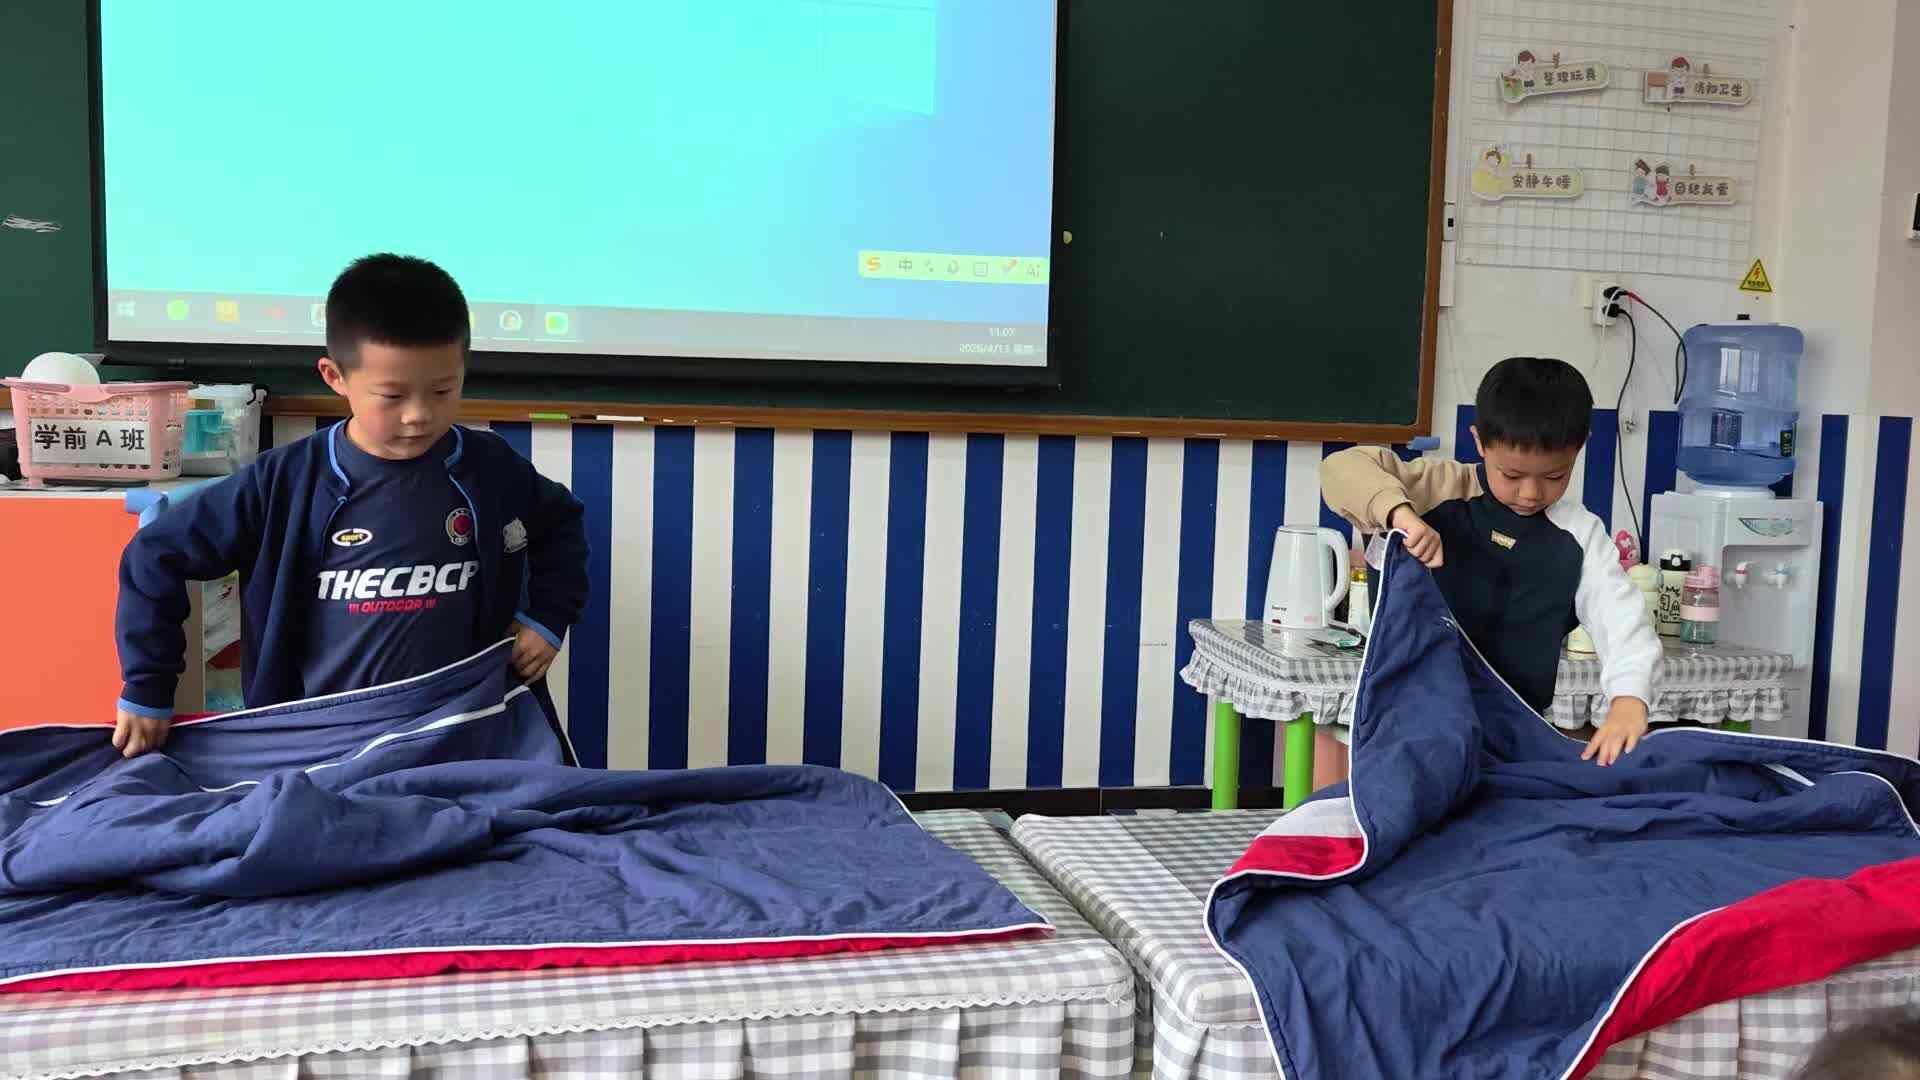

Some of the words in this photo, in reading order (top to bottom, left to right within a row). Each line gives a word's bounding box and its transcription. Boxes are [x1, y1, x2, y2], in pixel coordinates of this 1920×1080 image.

[1543, 67, 1597, 86] 整理玩具
[1512, 173, 1571, 190] 安静午睡
[1674, 181, 1729, 197] 团结友爱
[317, 560, 481, 600] THECBCP
